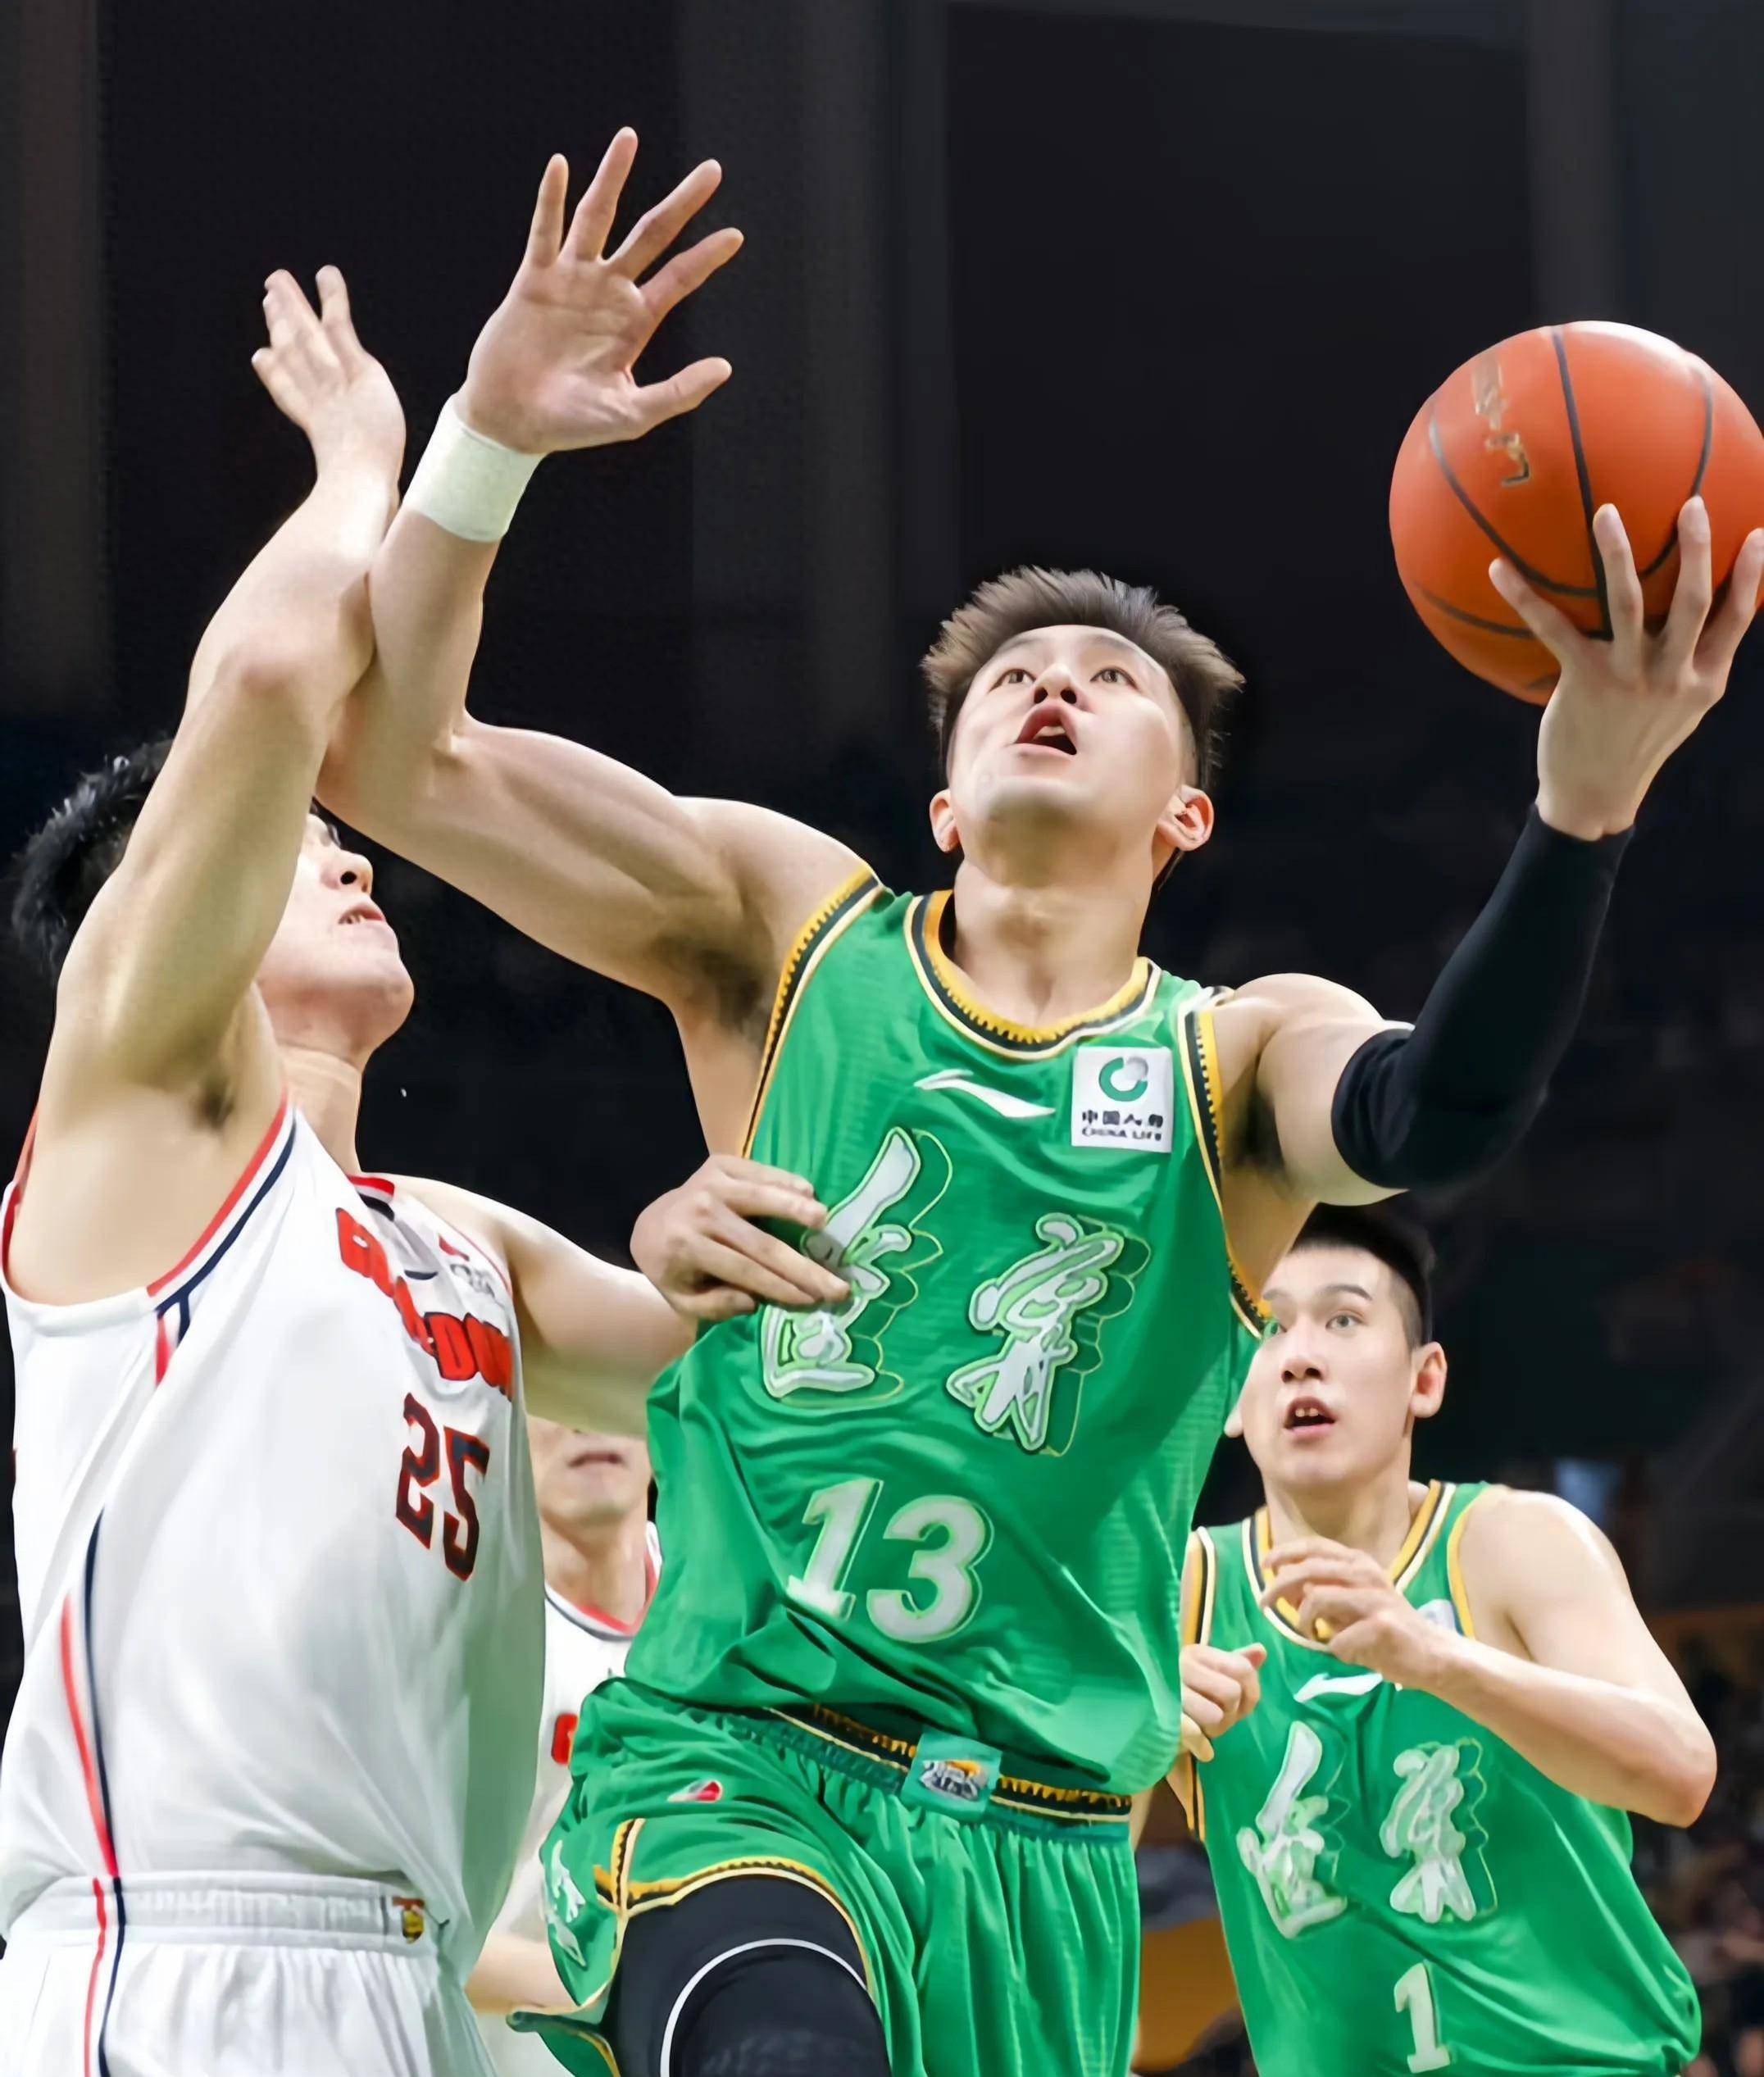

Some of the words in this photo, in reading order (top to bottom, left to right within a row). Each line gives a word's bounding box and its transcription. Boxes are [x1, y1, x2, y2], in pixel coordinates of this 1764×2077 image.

[396, 1392, 490, 1582] 25
[787, 1478, 991, 1643] 13
[1393, 1962, 1451, 2074] 1
